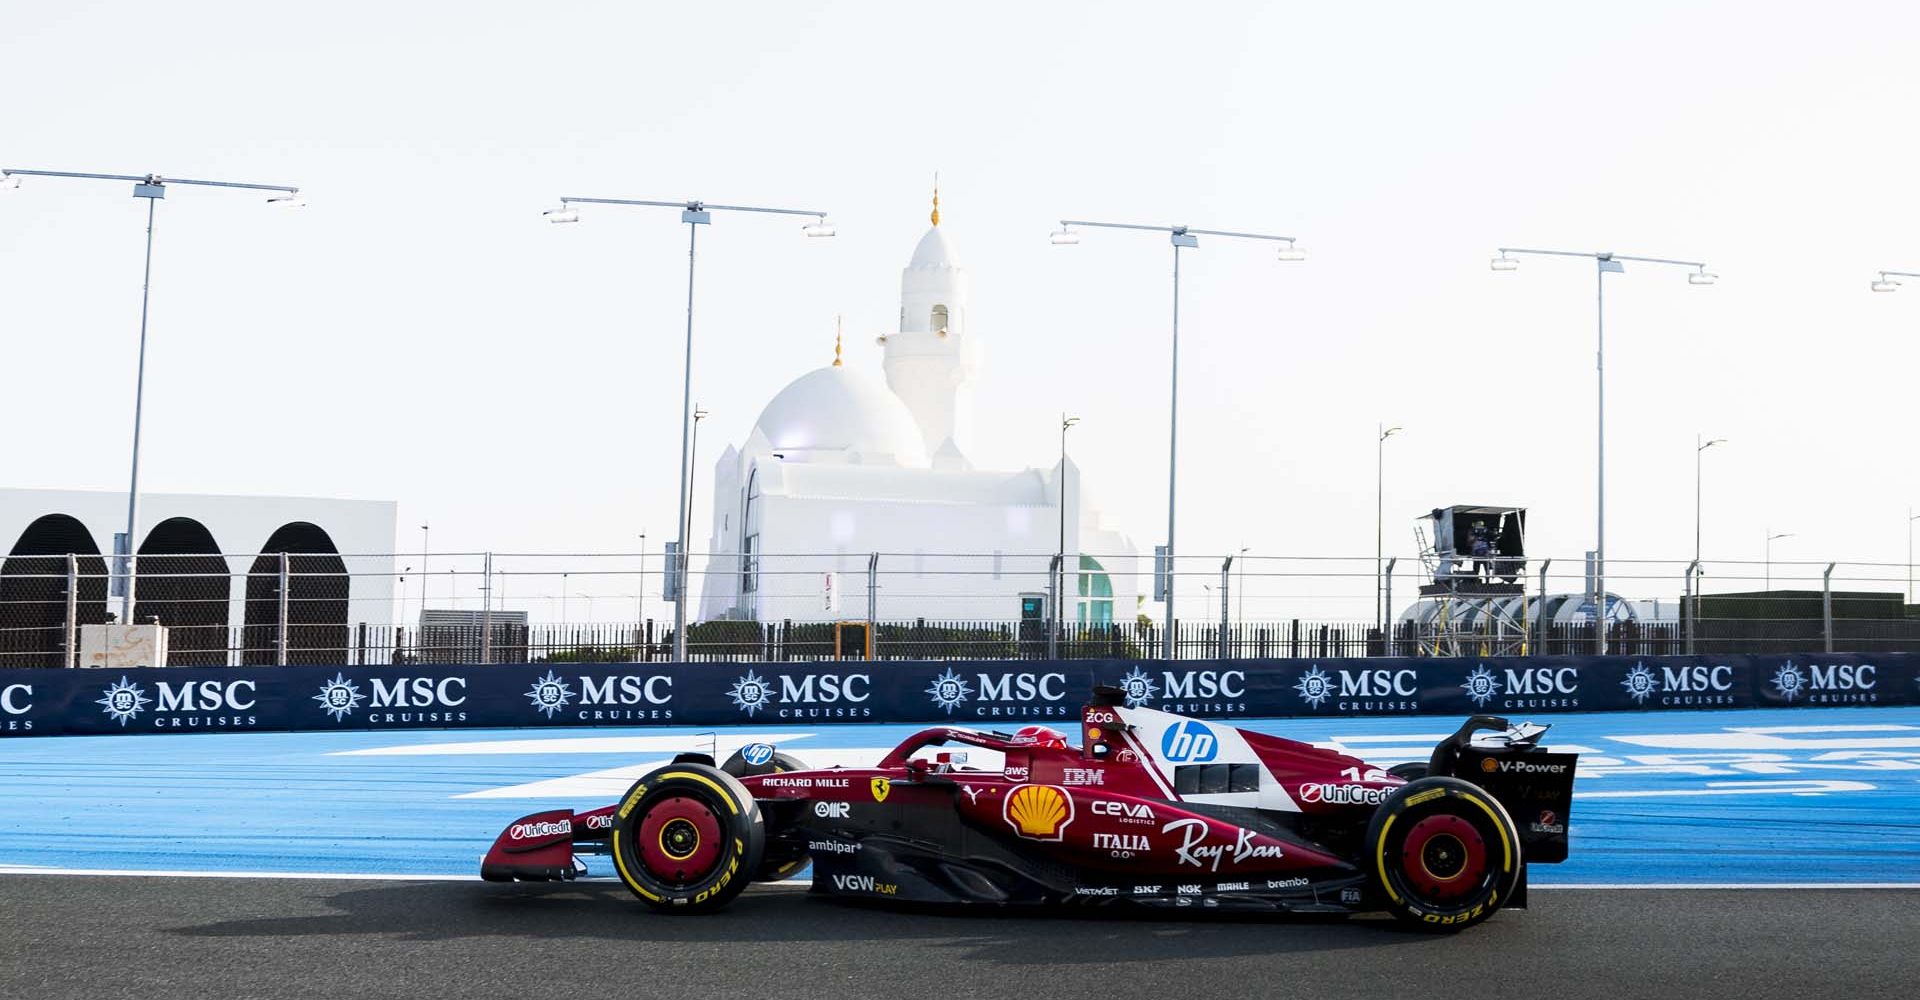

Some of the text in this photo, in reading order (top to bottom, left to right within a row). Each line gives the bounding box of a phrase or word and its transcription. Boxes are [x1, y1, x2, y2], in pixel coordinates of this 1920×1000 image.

[1339, 670, 1417, 696] MSC
[1505, 668, 1578, 694] MSC
[1662, 666, 1732, 691] MSC
[1810, 665, 1876, 690] MSC
[579, 676, 672, 705] MSC
[779, 674, 870, 703] MSC
[977, 673, 1066, 701] MSC
[1163, 671, 1245, 698] MSC
[155, 680, 256, 712] MSC
[370, 677, 466, 708] MSC
[1810, 694, 1877, 702] CRUISES
[1339, 702, 1417, 710] CRUISES
[1504, 700, 1578, 708] CRUISES
[1662, 696, 1733, 704] CRUISES
[780, 708, 870, 717] CRUISES
[977, 706, 1066, 715] CRUISES
[1163, 704, 1245, 712] CRUISES
[370, 712, 466, 722] CRUISES
[579, 710, 672, 719] CRUISES
[1086, 712, 1113, 723] ZCG
[155, 717, 256, 727] CRUISES
[1163, 721, 1217, 762] hp
[1004, 766, 1029, 777] aws
[1500, 761, 1567, 773] V-Power
[1063, 768, 1105, 785] IBM
[762, 778, 849, 788] RICHARD MILLE
[524, 819, 572, 837] UniCredit
[1093, 833, 1151, 851] ITALIA
[832, 875, 897, 895] VGW PLAY
[1178, 884, 1202, 894] NGK
[1217, 881, 1250, 891] MAHLE
[1267, 877, 1309, 889] brembo
[1134, 885, 1162, 894] SKF
